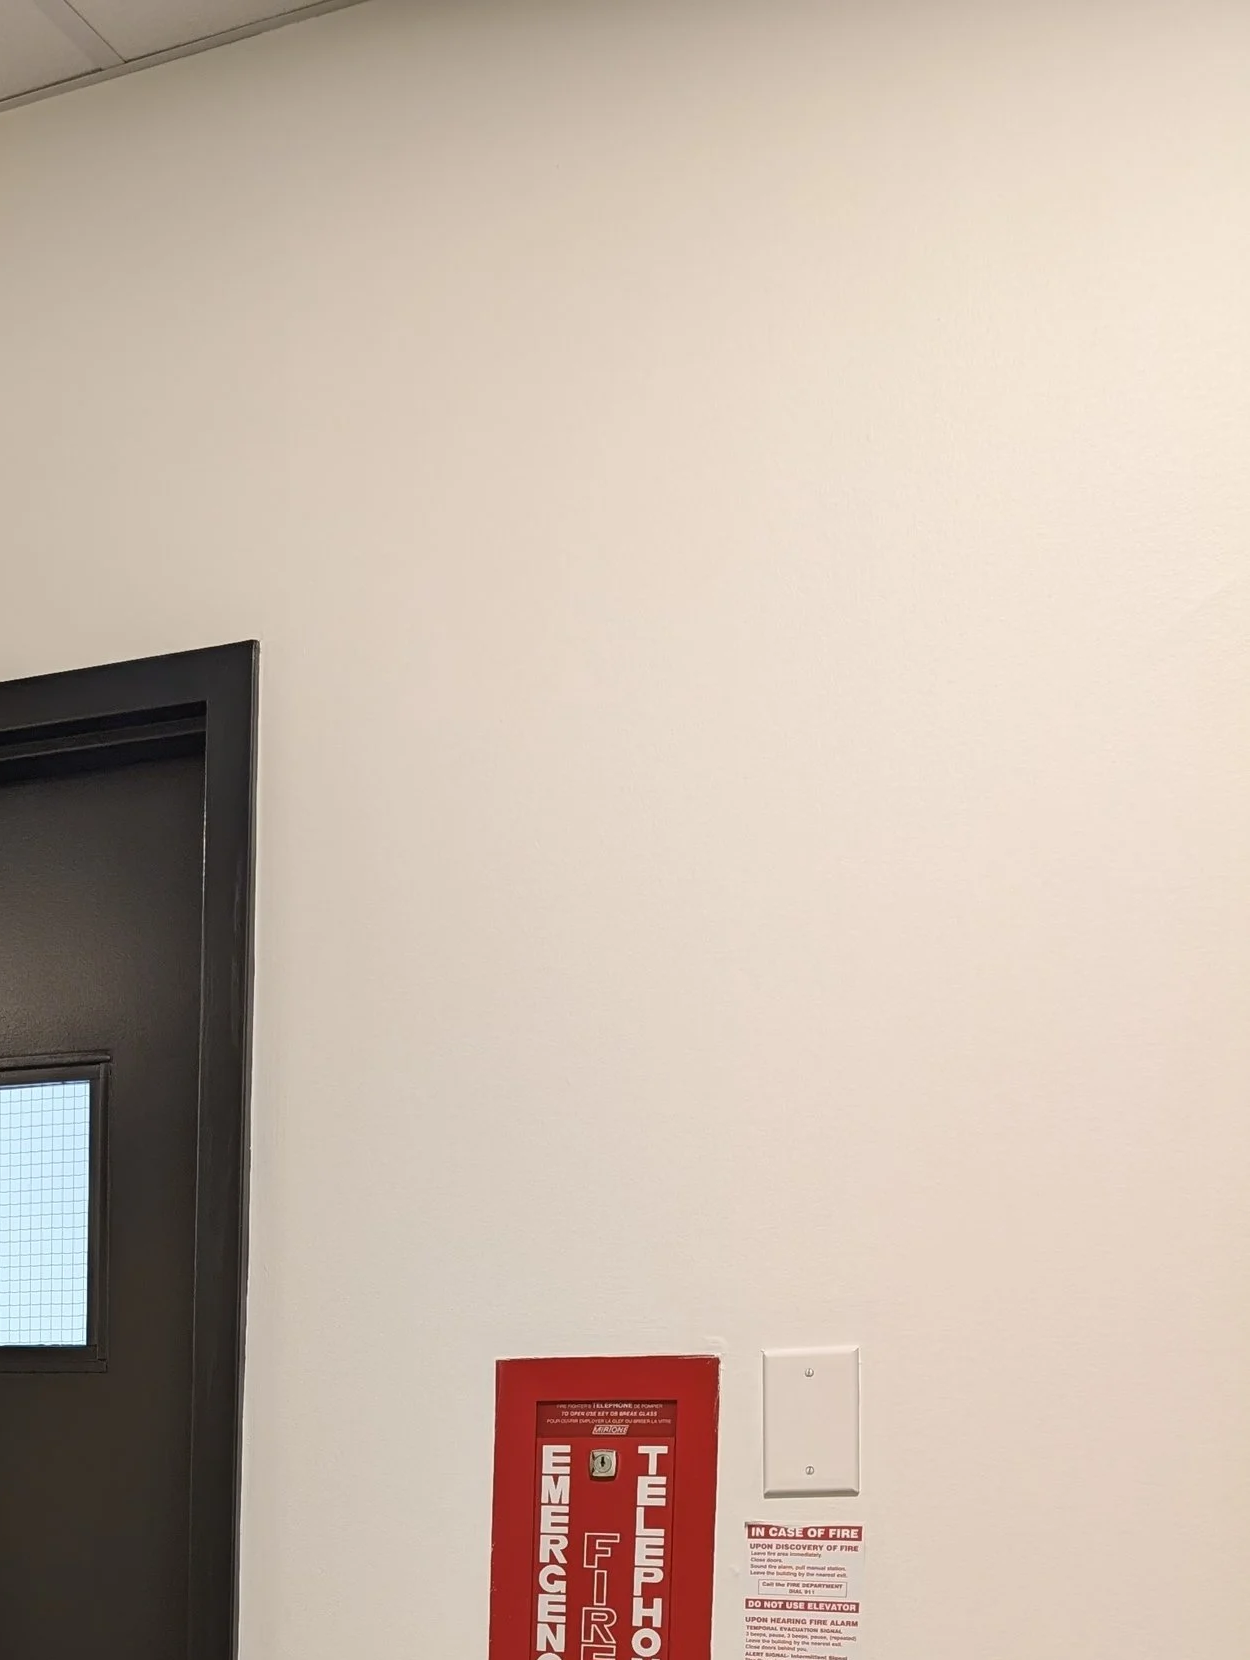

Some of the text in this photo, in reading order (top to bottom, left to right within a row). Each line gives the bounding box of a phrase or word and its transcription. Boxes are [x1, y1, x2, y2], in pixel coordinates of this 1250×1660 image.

[752, 1527, 859, 1538] IN CASE OF FIRE
[764, 1601, 783, 1609] NOT
[808, 1603, 856, 1611] ELEVATOR
